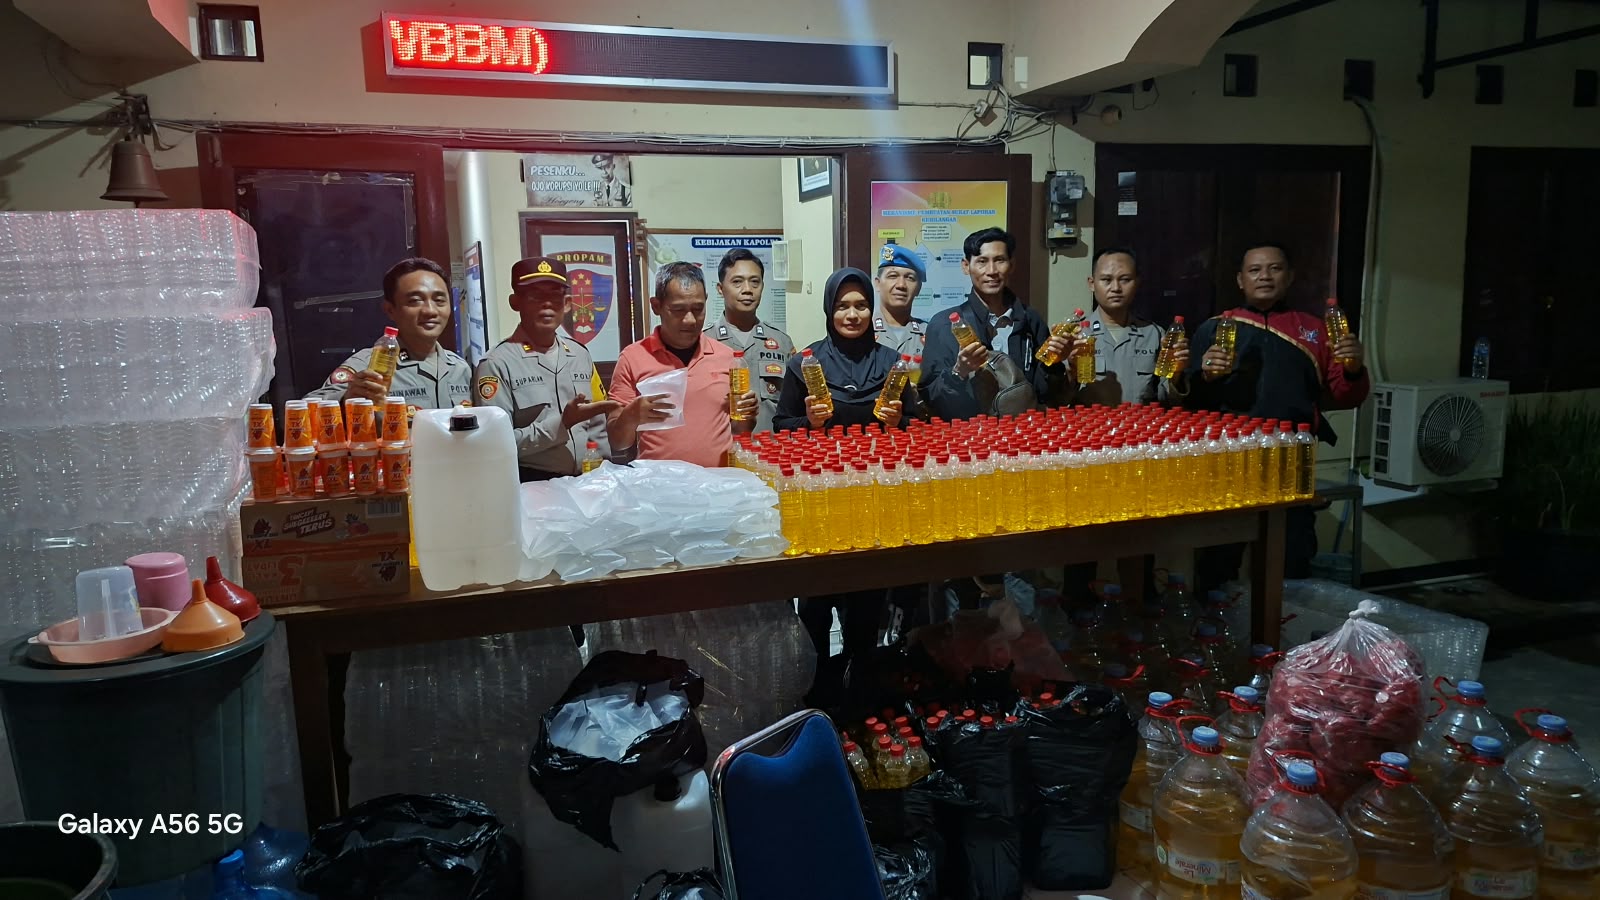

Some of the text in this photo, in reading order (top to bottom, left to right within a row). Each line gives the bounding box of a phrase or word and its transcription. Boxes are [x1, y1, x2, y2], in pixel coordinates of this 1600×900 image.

[530, 165, 586, 177] PESENKU...
[531, 180, 544, 191] OJO
[545, 180, 573, 191] KORUPSI
[574, 180, 583, 191] YO
[584, 180, 592, 191] LE
[694, 238, 778, 246] KEBIJAKAN KAPOL
[556, 254, 604, 263] PROPAM
[300, 518, 333, 535] TERUS
